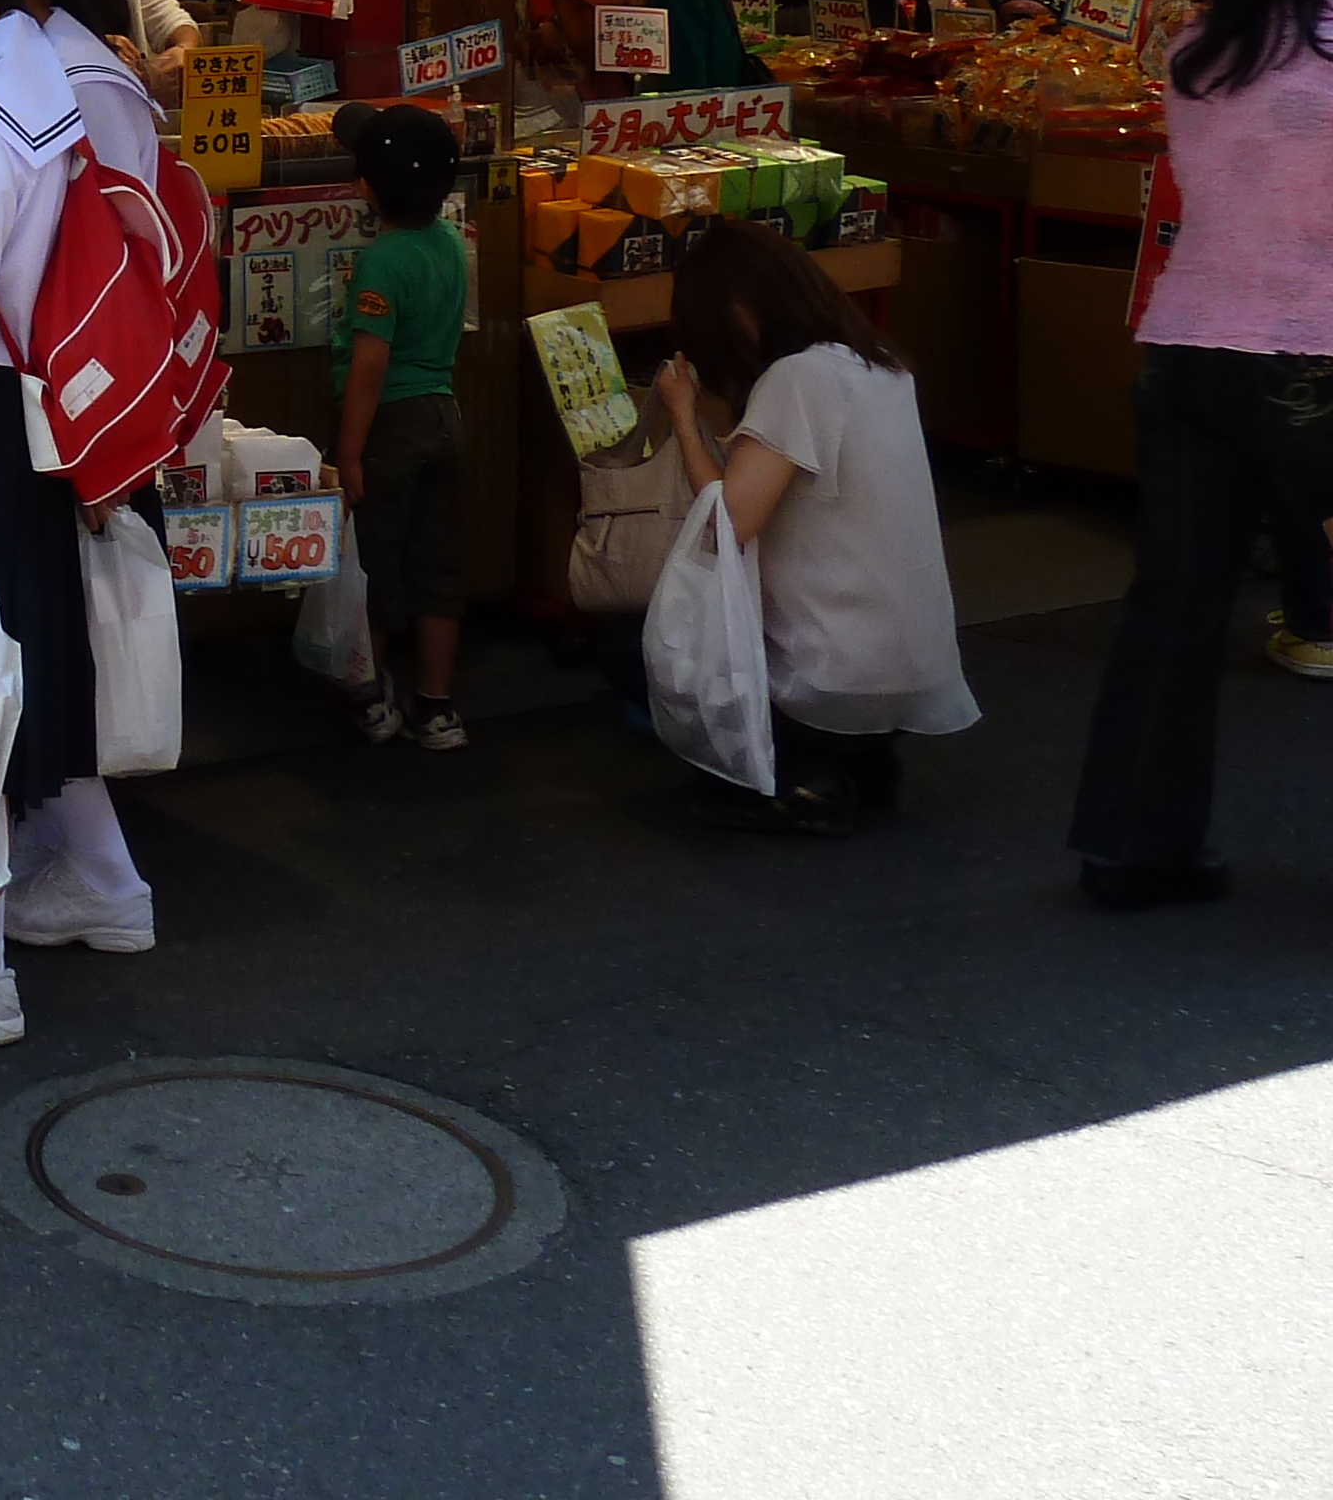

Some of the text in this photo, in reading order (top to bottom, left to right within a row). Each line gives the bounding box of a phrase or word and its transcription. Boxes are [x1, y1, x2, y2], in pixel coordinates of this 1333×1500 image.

[192, 55, 255, 74] やきたて
[583, 93, 792, 155] 今月の大サービス
[192, 132, 251, 155] 50円
[246, 533, 326, 571] ¥500
